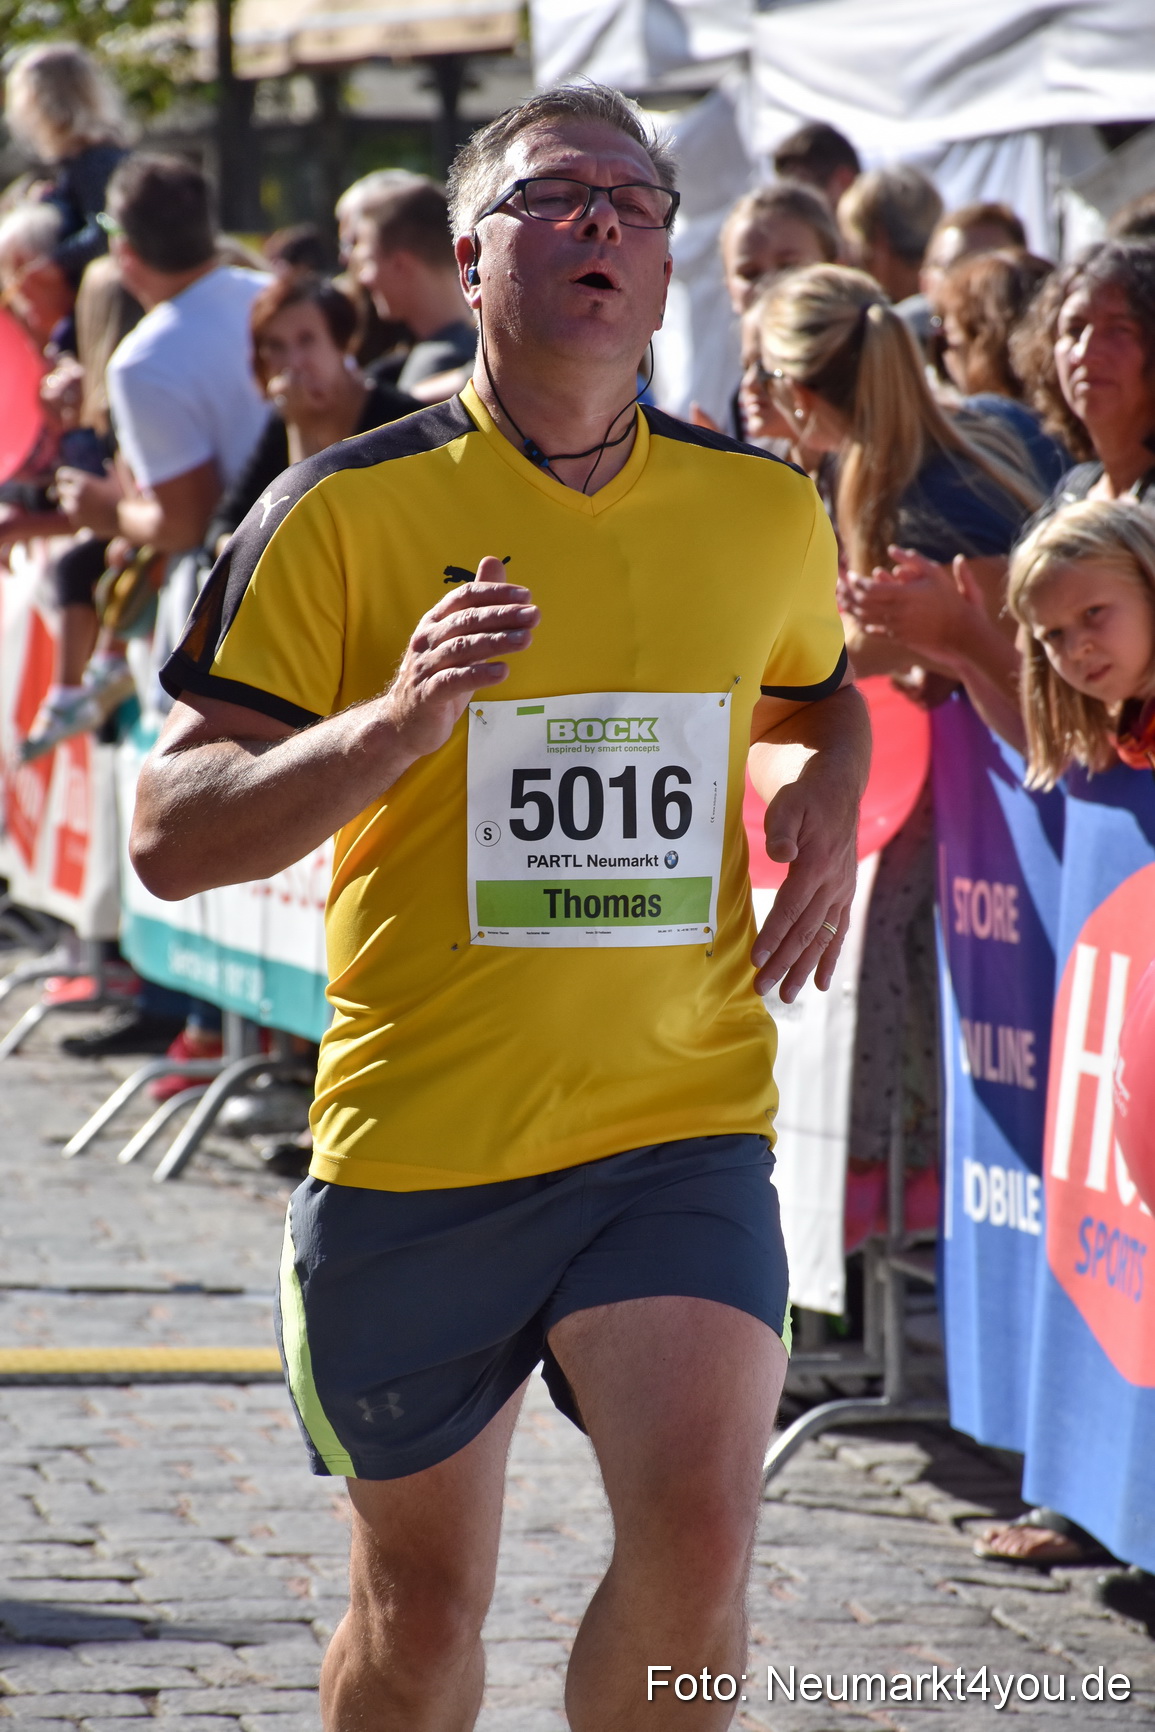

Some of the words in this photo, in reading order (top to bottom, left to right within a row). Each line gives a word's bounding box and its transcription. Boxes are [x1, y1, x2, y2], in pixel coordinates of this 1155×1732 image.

[547, 717, 659, 744] BOCK
[547, 745, 582, 754] inspired
[585, 745, 595, 754] by
[624, 744, 660, 753] concepts
[509, 765, 693, 841] 5016
[527, 854, 583, 868] PARTL
[587, 854, 659, 868] Neumarkt
[543, 888, 662, 919] Thomas
[953, 877, 1020, 945] STORE
[1075, 1215, 1147, 1303] SPORTS
